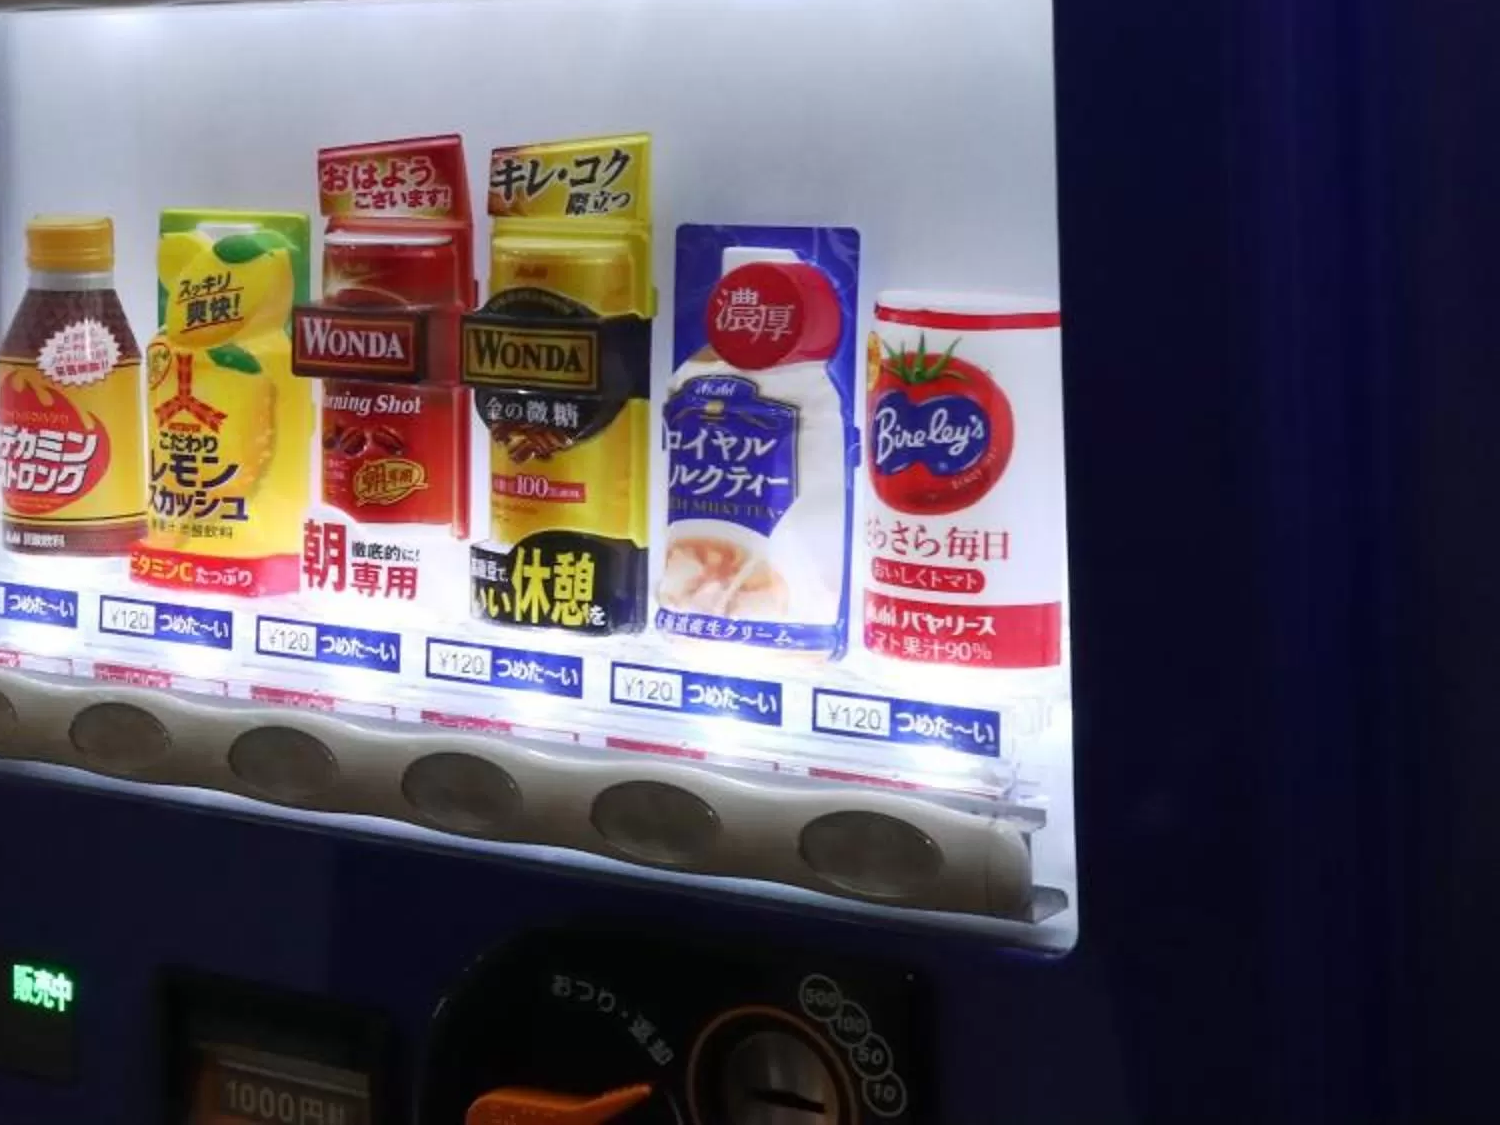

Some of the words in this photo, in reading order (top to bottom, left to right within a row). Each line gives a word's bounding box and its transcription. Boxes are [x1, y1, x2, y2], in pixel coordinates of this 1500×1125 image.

[322, 156, 435, 192] おはよう
[489, 148, 631, 202] キレ・コク
[354, 187, 451, 210] ございます!
[565, 189, 632, 216] 際立つ
[179, 272, 232, 298] スッキリ
[185, 293, 241, 328] 爽快!
[715, 286, 796, 344] 濃厚
[323, 390, 373, 416] rning
[373, 394, 421, 415] Shot
[485, 396, 579, 428] 金の微糖
[159, 429, 220, 453] こだわり
[668, 428, 777, 461] ロイヤル
[876, 407, 985, 465] Bireley's
[148, 448, 240, 490] レモン
[668, 463, 789, 498] ルクティー
[302, 518, 347, 592] 朝
[350, 562, 418, 601] 専用
[110, 607, 150, 630] ¥120
[900, 610, 997, 636] バヤリース
[268, 627, 312, 652] ¥120
[870, 629, 993, 661] マト果汁90%
[438, 650, 485, 676] ¥120
[620, 674, 674, 703] ¥120
[827, 701, 884, 731] ¥120
[13, 965, 74, 1012] 販売中
[856, 1046, 884, 1066] 50
[872, 1082, 897, 1104] 10
